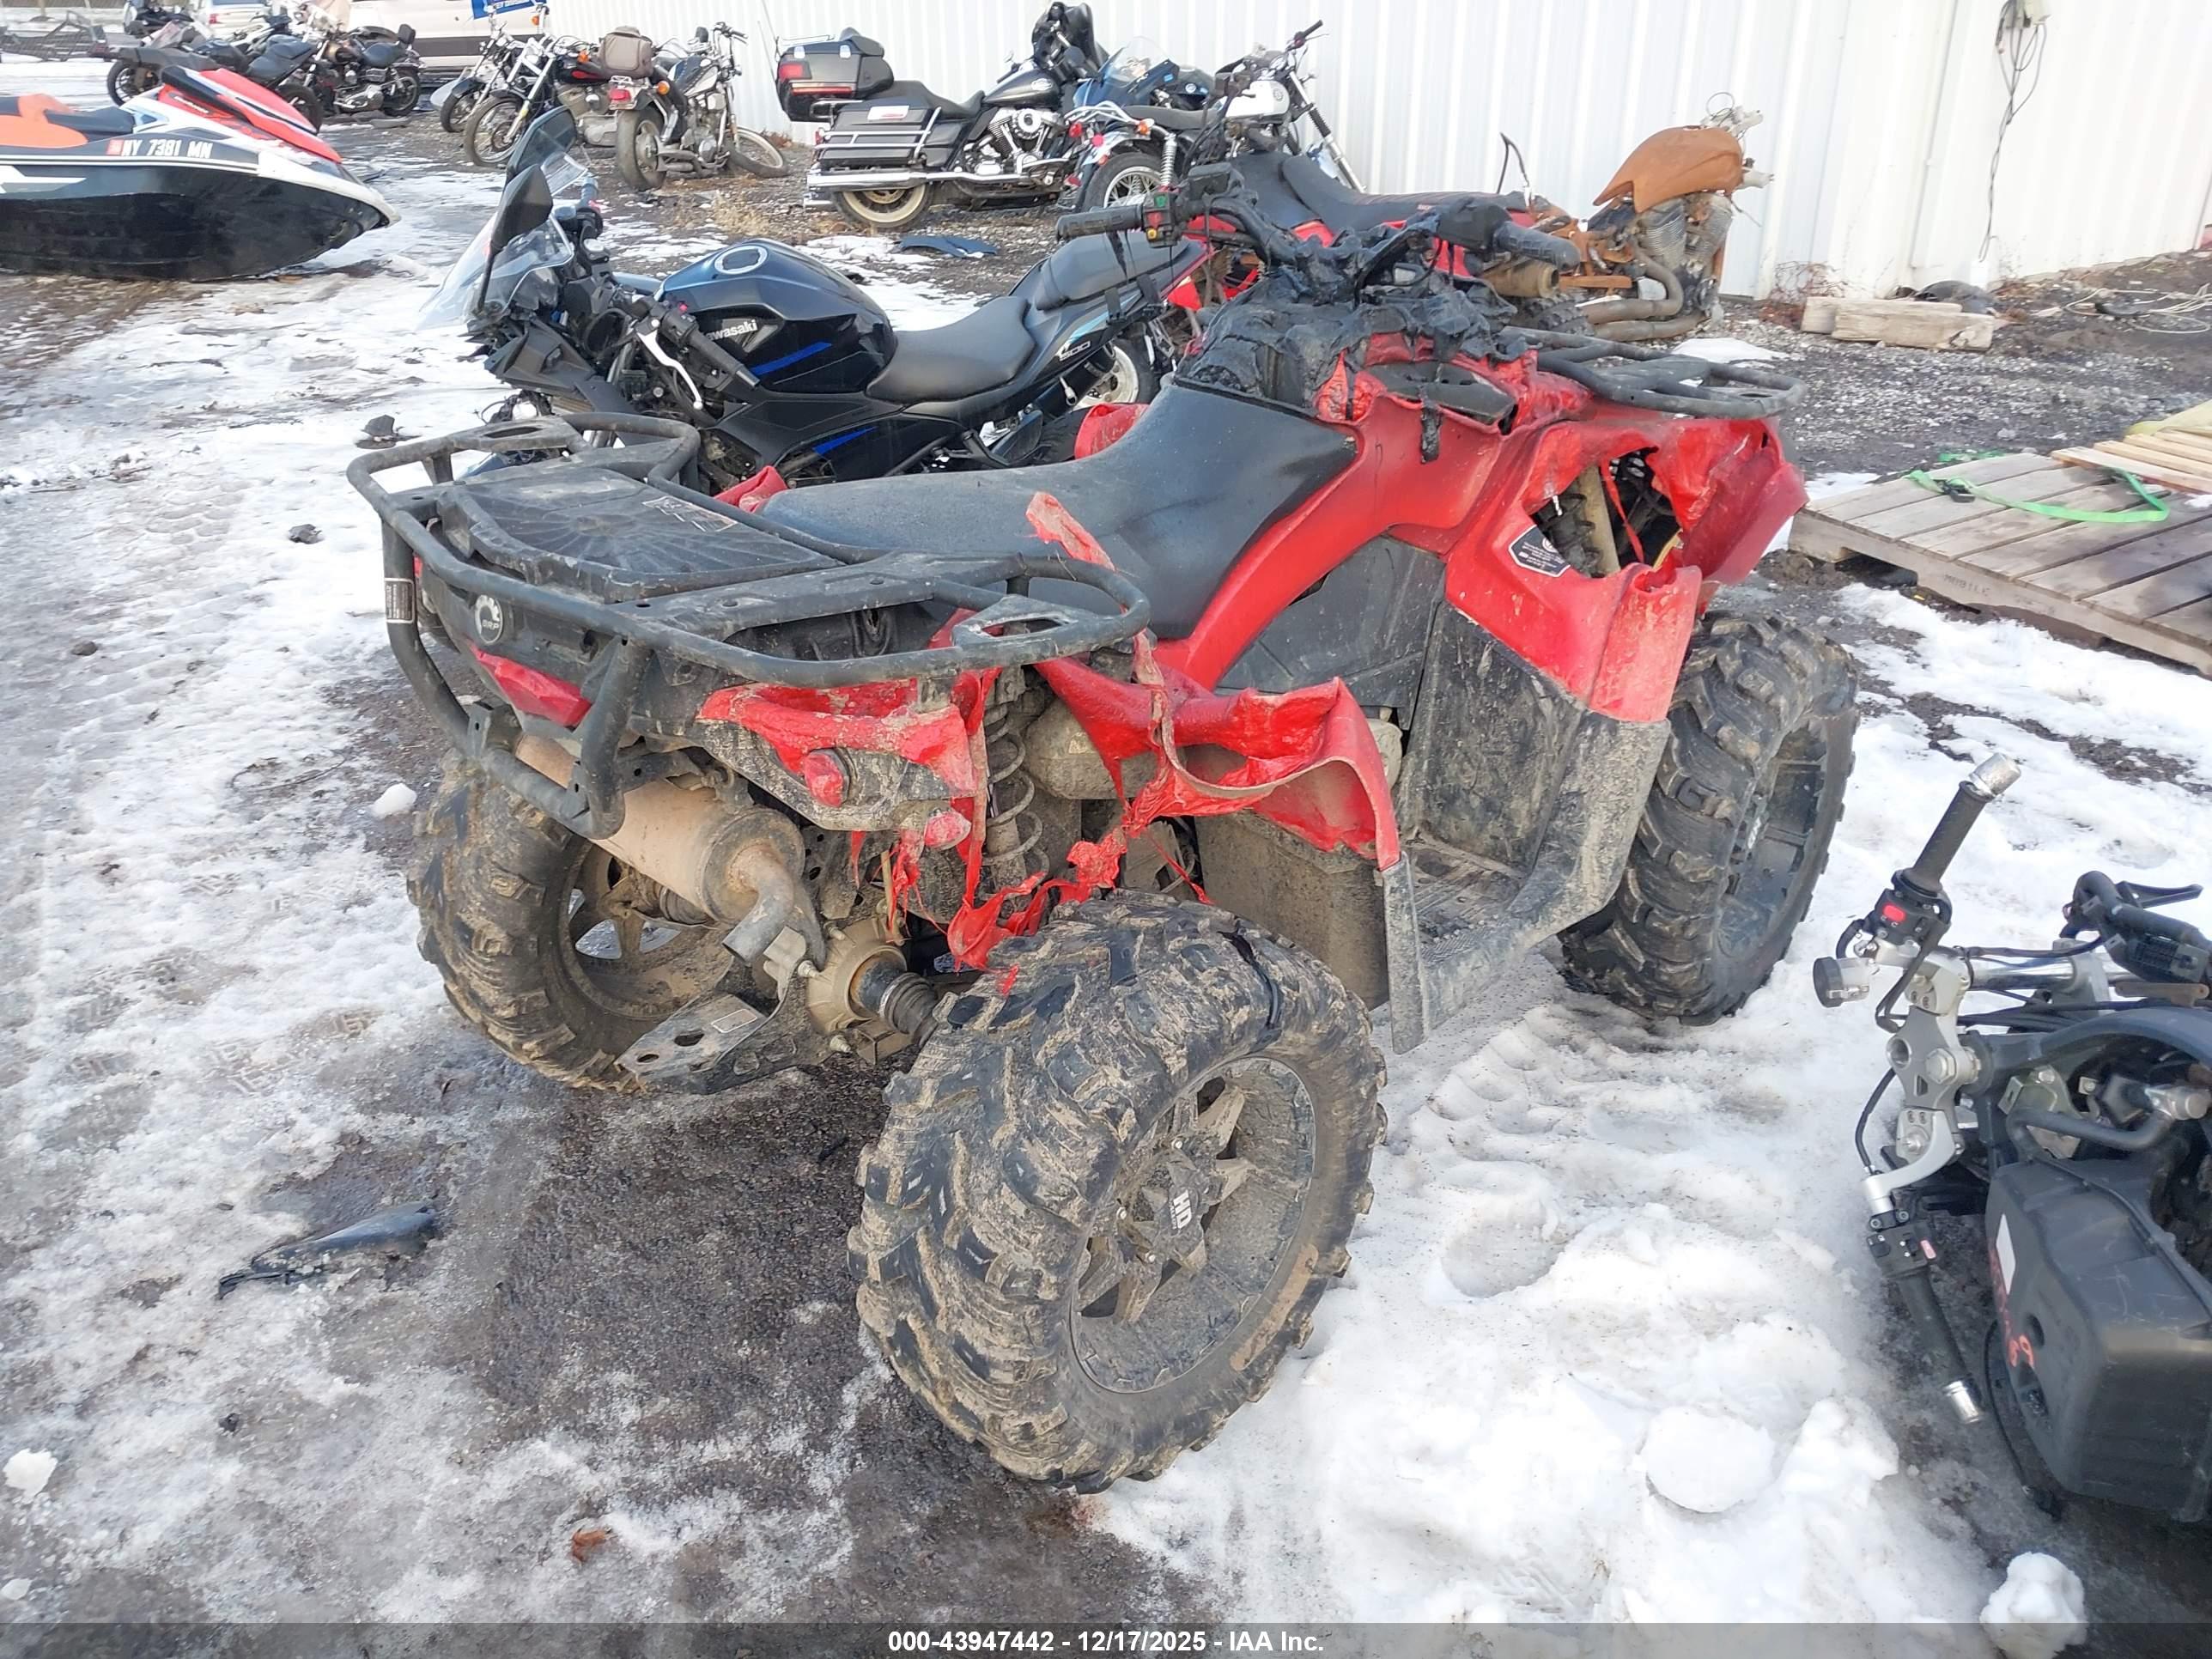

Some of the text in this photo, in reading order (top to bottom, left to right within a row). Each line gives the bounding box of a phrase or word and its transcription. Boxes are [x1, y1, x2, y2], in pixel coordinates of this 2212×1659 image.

[121, 139, 143, 156] NY
[186, 141, 213, 159] MN
[705, 319, 758, 341] awasaki
[481, 618, 500, 631] BRP
[1173, 1188, 1193, 1230] HD
